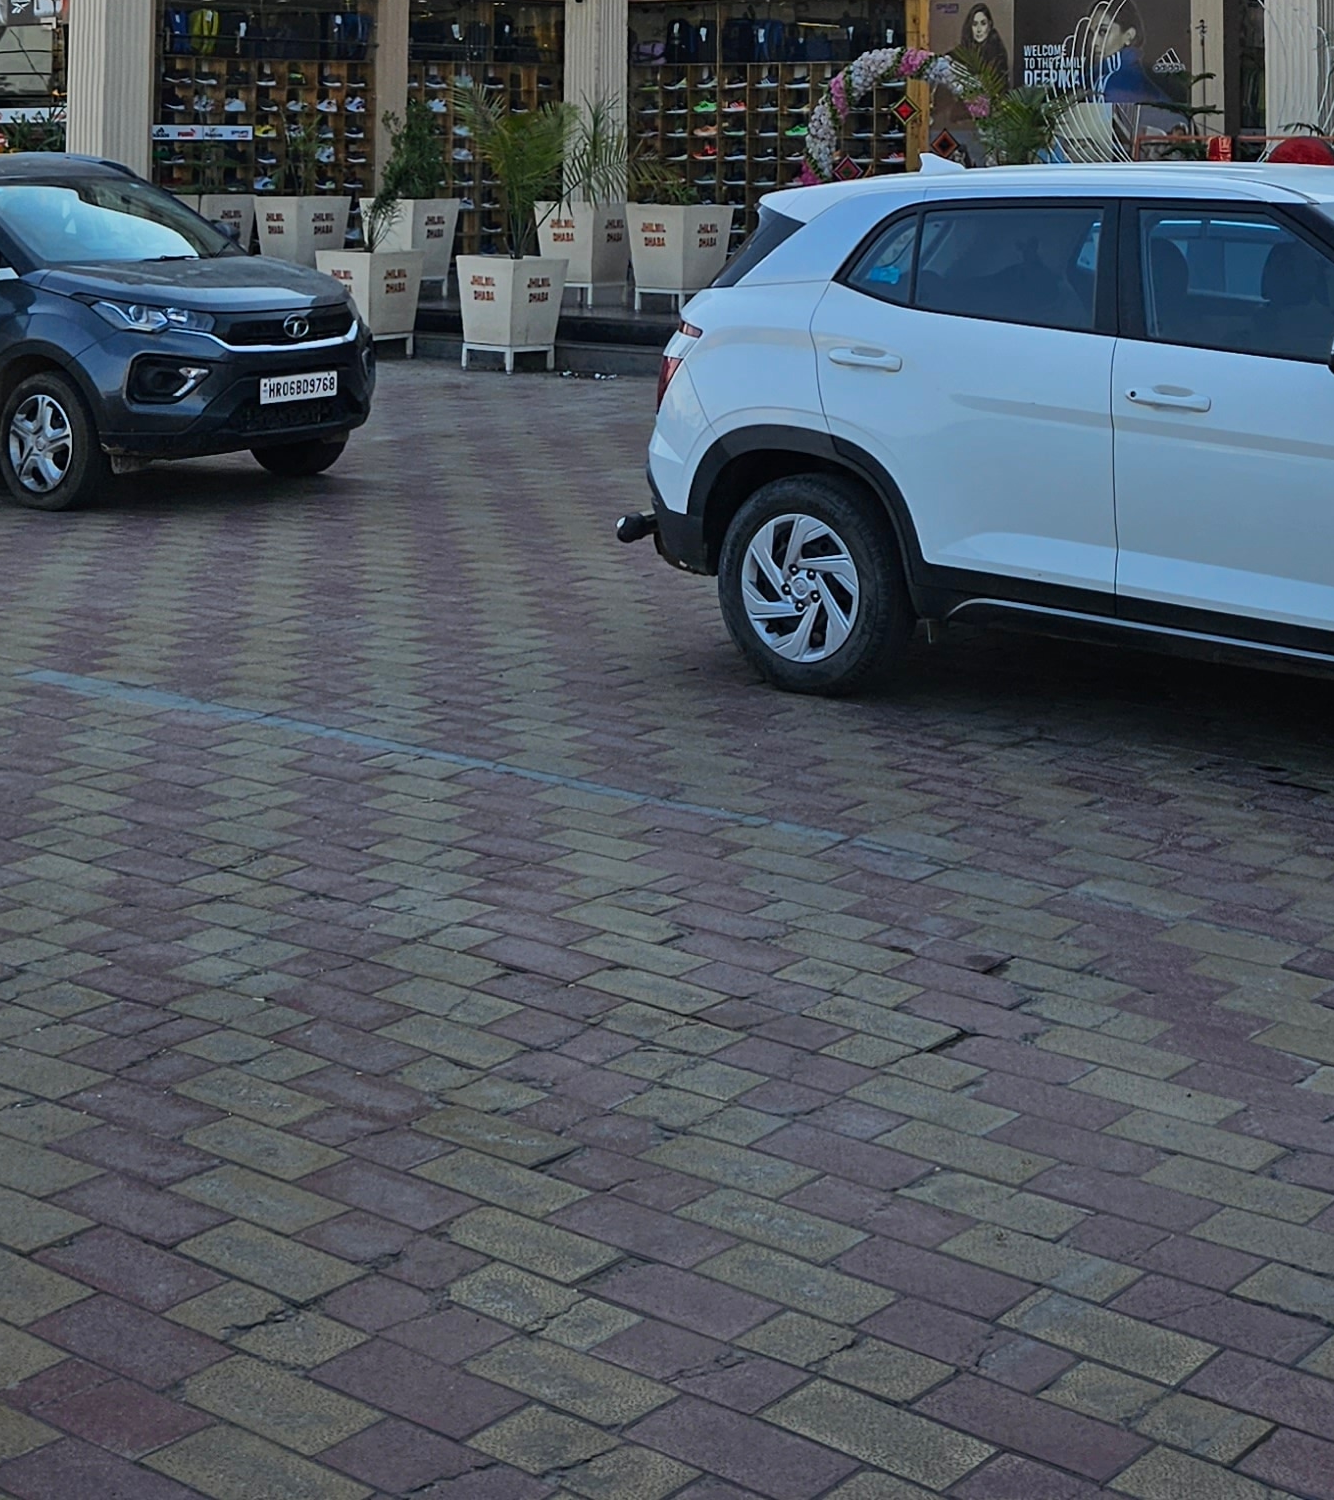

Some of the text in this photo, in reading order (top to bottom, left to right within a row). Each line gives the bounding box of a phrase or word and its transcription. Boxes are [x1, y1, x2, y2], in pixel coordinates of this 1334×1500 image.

[1024, 44, 1067, 56] WELCOME
[1024, 57, 1035, 69] TO
[268, 374, 336, 398] HR06BD9768
